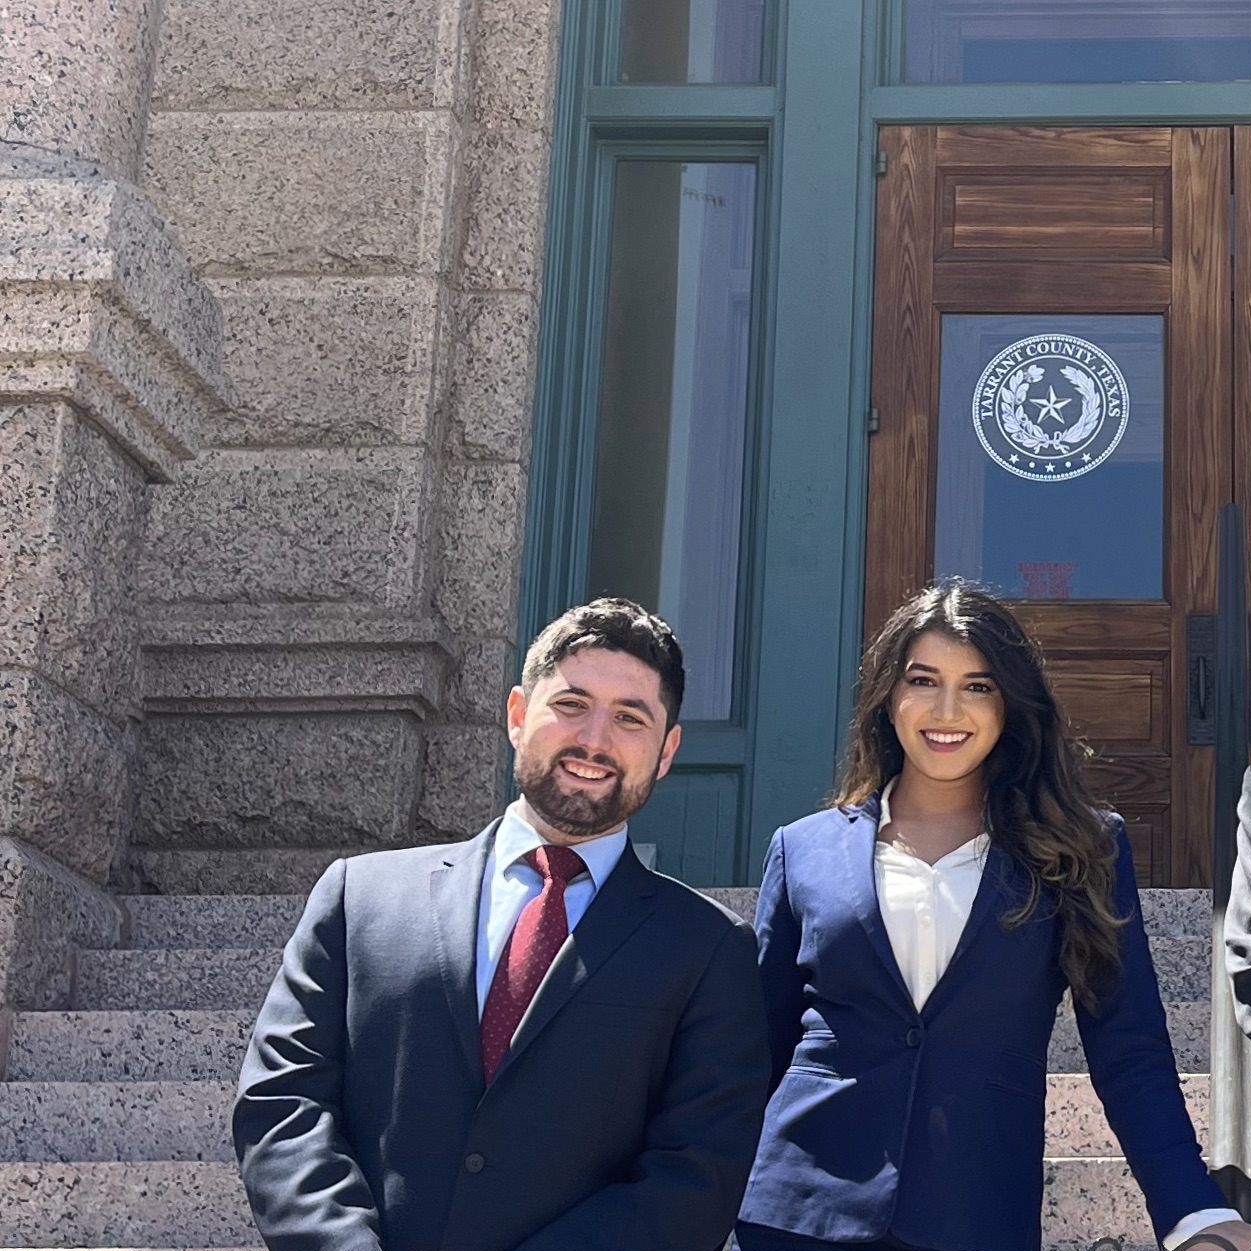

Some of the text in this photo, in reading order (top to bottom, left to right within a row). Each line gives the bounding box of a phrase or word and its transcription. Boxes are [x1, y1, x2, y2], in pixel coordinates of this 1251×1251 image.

[981, 342, 1121, 420] TARRANT COUNTY, TEXAS
